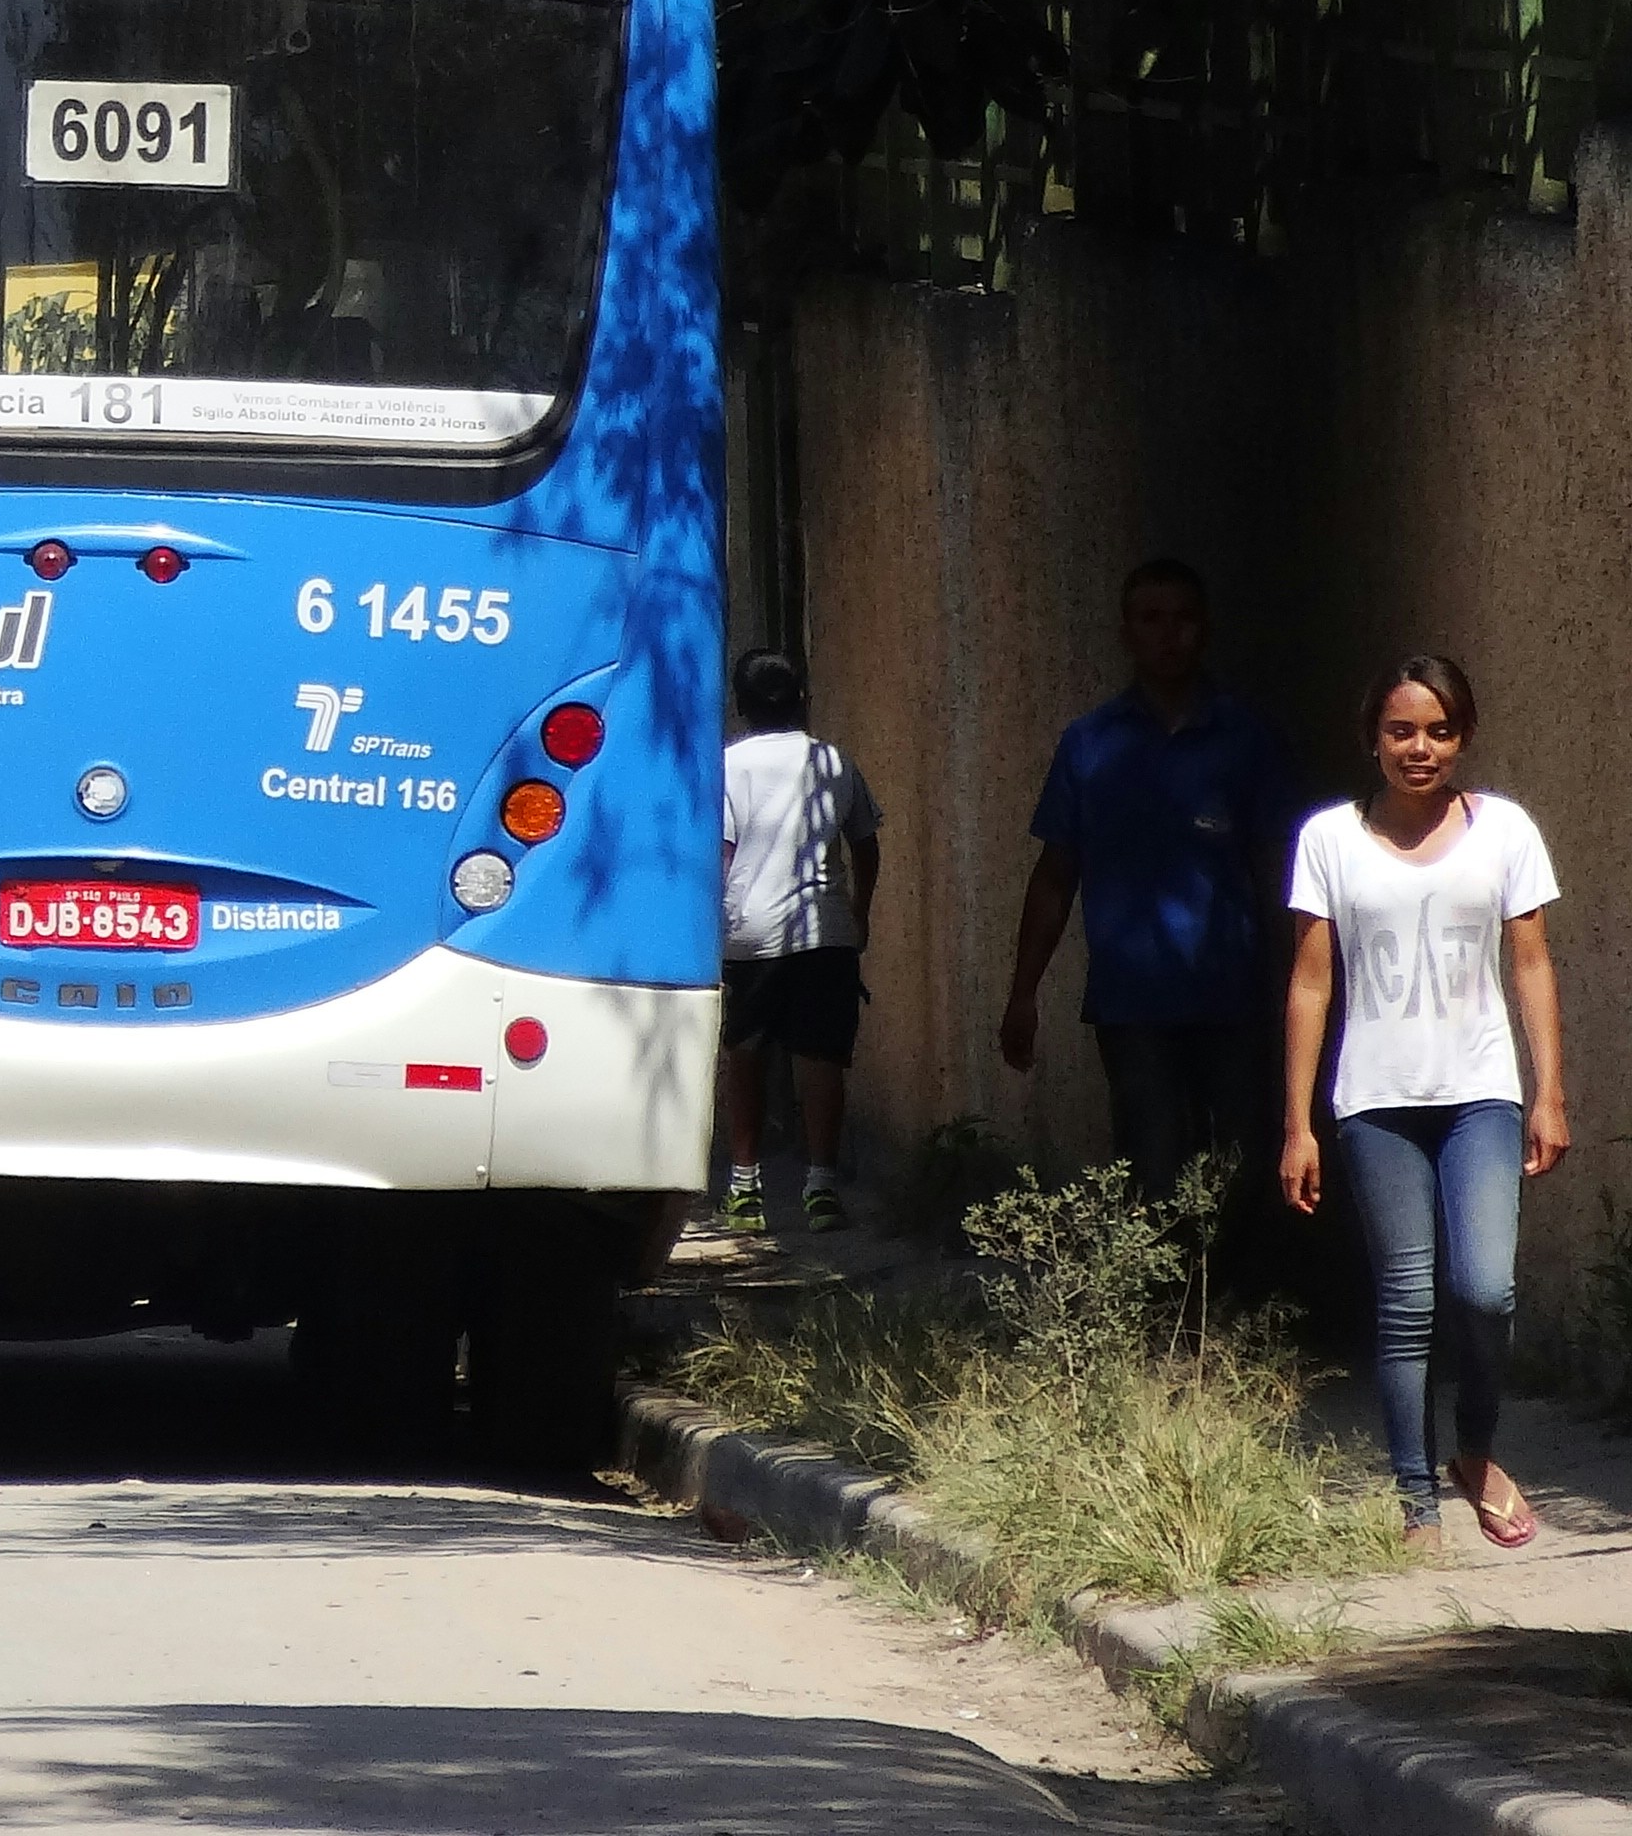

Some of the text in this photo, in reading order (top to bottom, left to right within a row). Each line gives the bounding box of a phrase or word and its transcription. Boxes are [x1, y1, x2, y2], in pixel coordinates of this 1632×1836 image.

[51, 98, 208, 165] 6091
[69, 381, 164, 425] 181
[192, 405, 234, 421] Sigilo
[237, 407, 307, 422] Absoluto
[320, 412, 416, 428] Atendimento
[419, 415, 437, 428] 24
[441, 417, 487, 432] Horas
[232, 392, 282, 406] Vamos
[286, 394, 360, 410] Combater
[378, 399, 446, 414] Violência
[296, 578, 511, 645] 6 1455
[350, 736, 433, 759] SPTrans
[261, 767, 457, 812] Central 156
[211, 902, 341, 932] Distância
